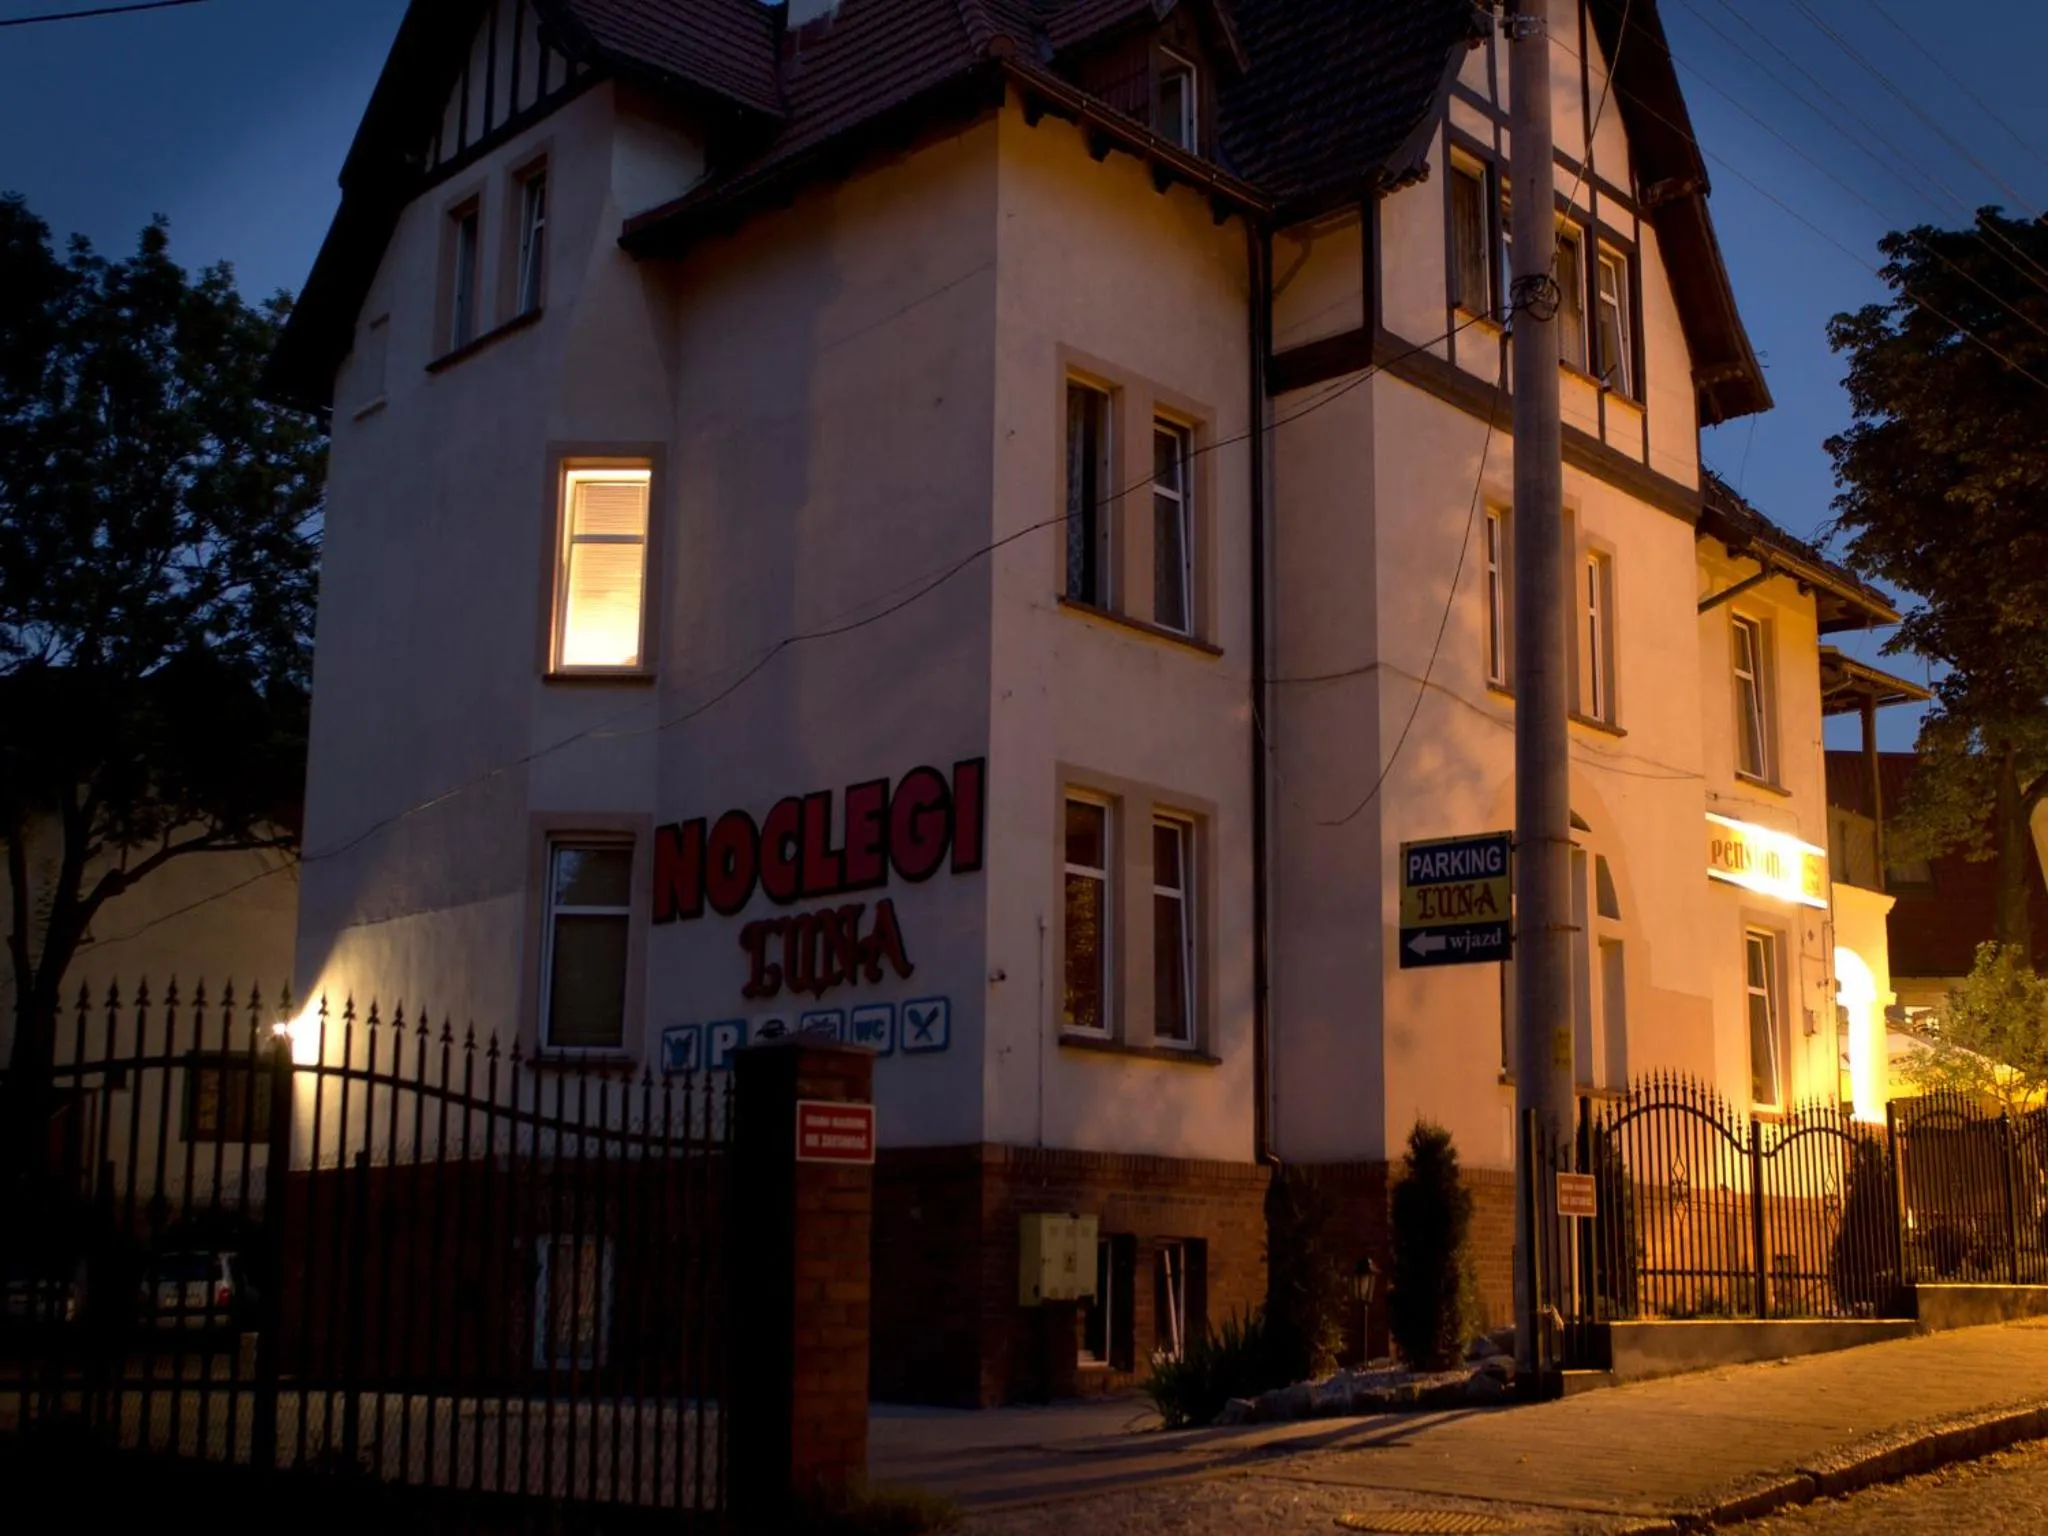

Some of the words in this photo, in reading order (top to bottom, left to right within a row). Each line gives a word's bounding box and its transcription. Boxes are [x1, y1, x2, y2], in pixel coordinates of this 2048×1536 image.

[653, 758, 985, 924] NOCLEGI
[1409, 845, 1502, 881] PARKING
[1417, 882, 1499, 920] LUNA
[740, 899, 914, 999] LUNA
[1448, 927, 1502, 954] wjazd
[712, 1025, 738, 1066] P
[855, 1018, 885, 1041] WC
